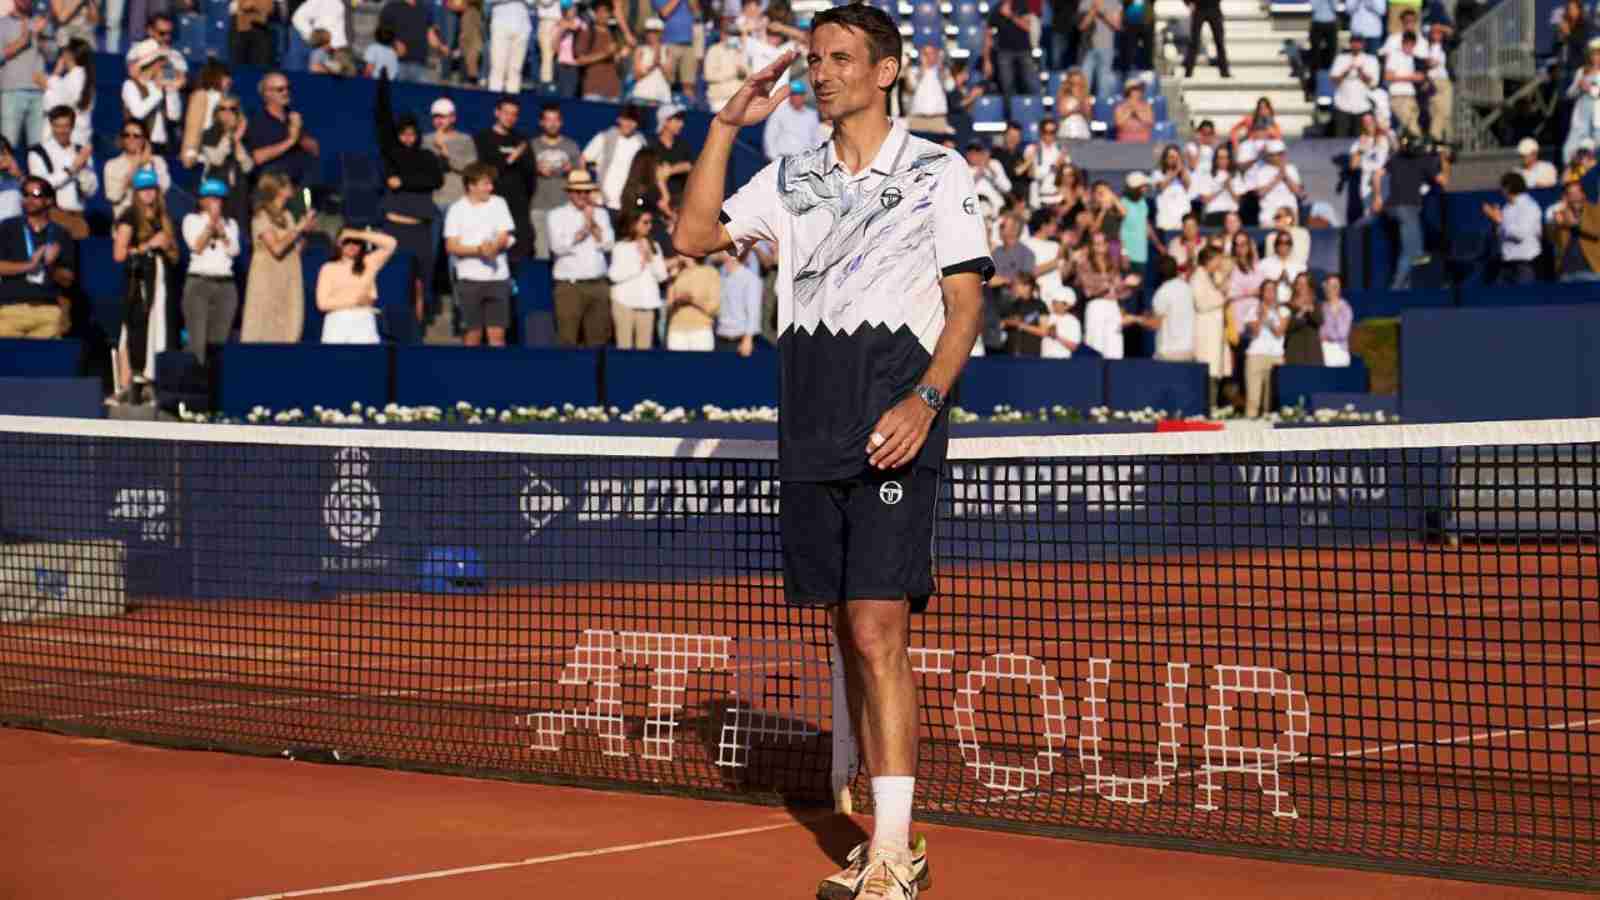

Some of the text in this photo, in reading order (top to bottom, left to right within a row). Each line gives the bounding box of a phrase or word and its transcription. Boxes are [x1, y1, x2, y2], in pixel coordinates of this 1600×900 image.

[951, 465, 1146, 516] MAPFRE
[514, 629, 1311, 818] ATP OUR
